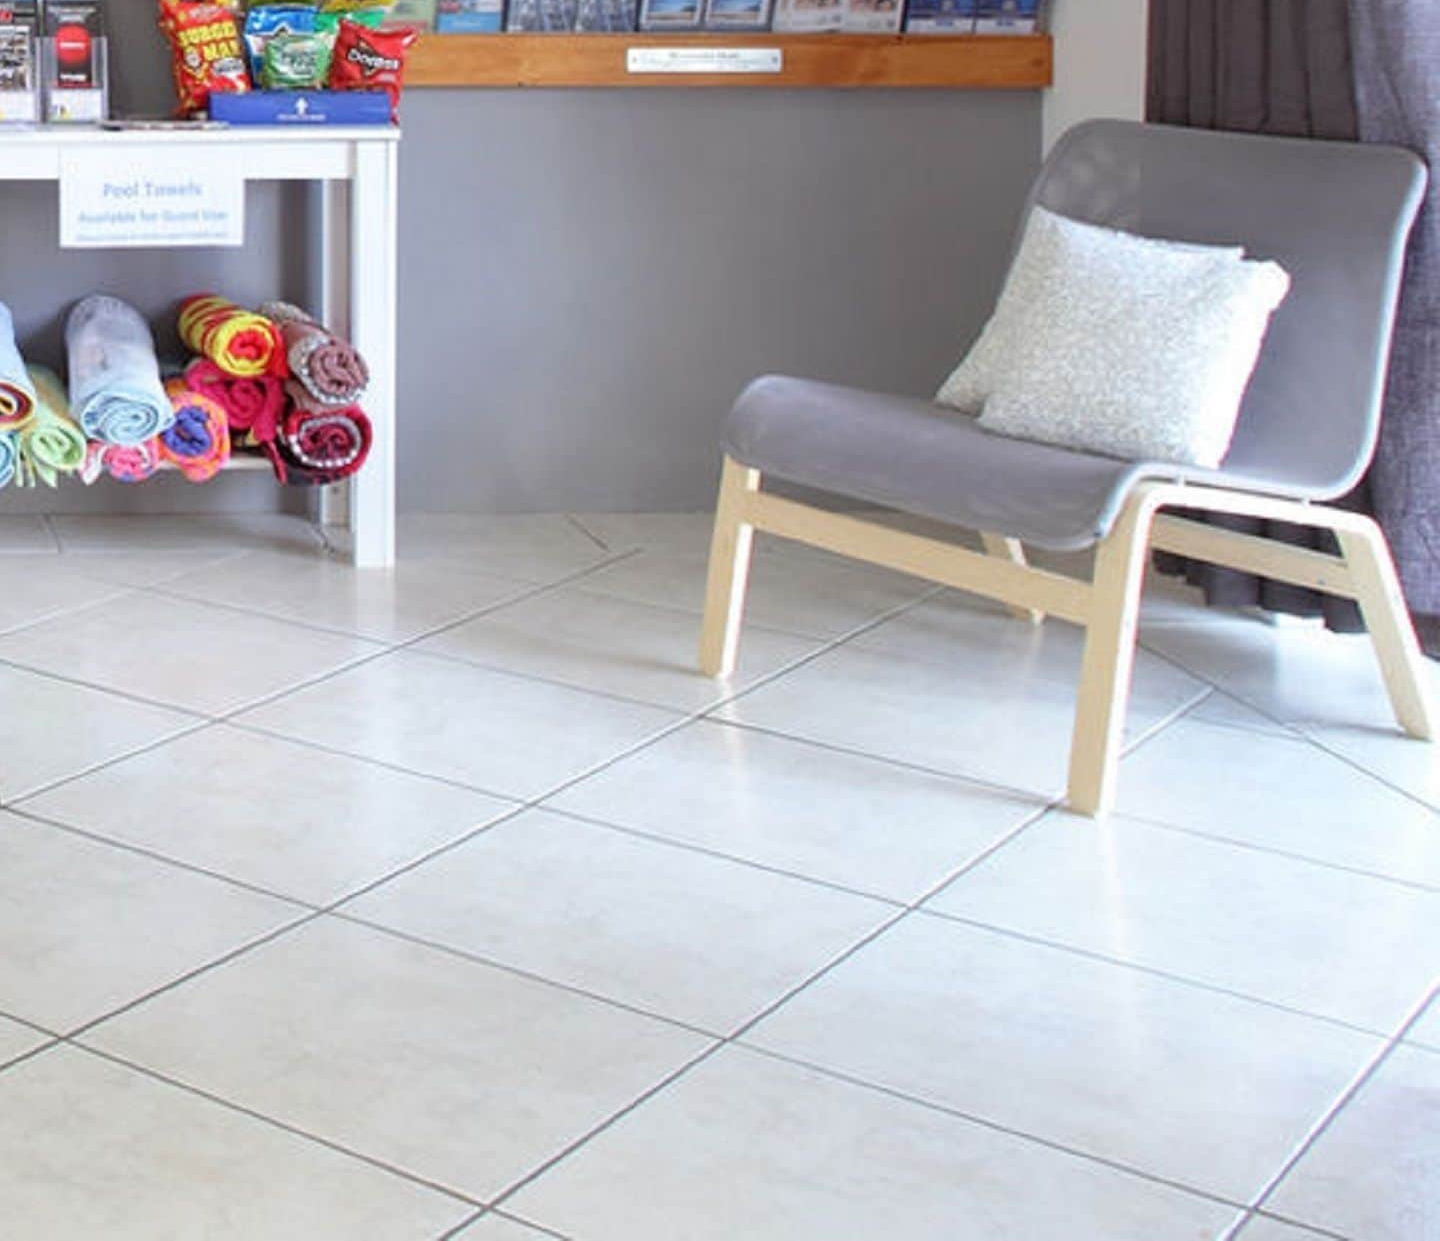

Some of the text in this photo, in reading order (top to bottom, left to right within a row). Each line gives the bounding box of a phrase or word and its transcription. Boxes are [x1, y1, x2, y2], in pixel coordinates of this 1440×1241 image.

[103, 180, 202, 198] Pool Towels
[78, 210, 136, 224] Available
